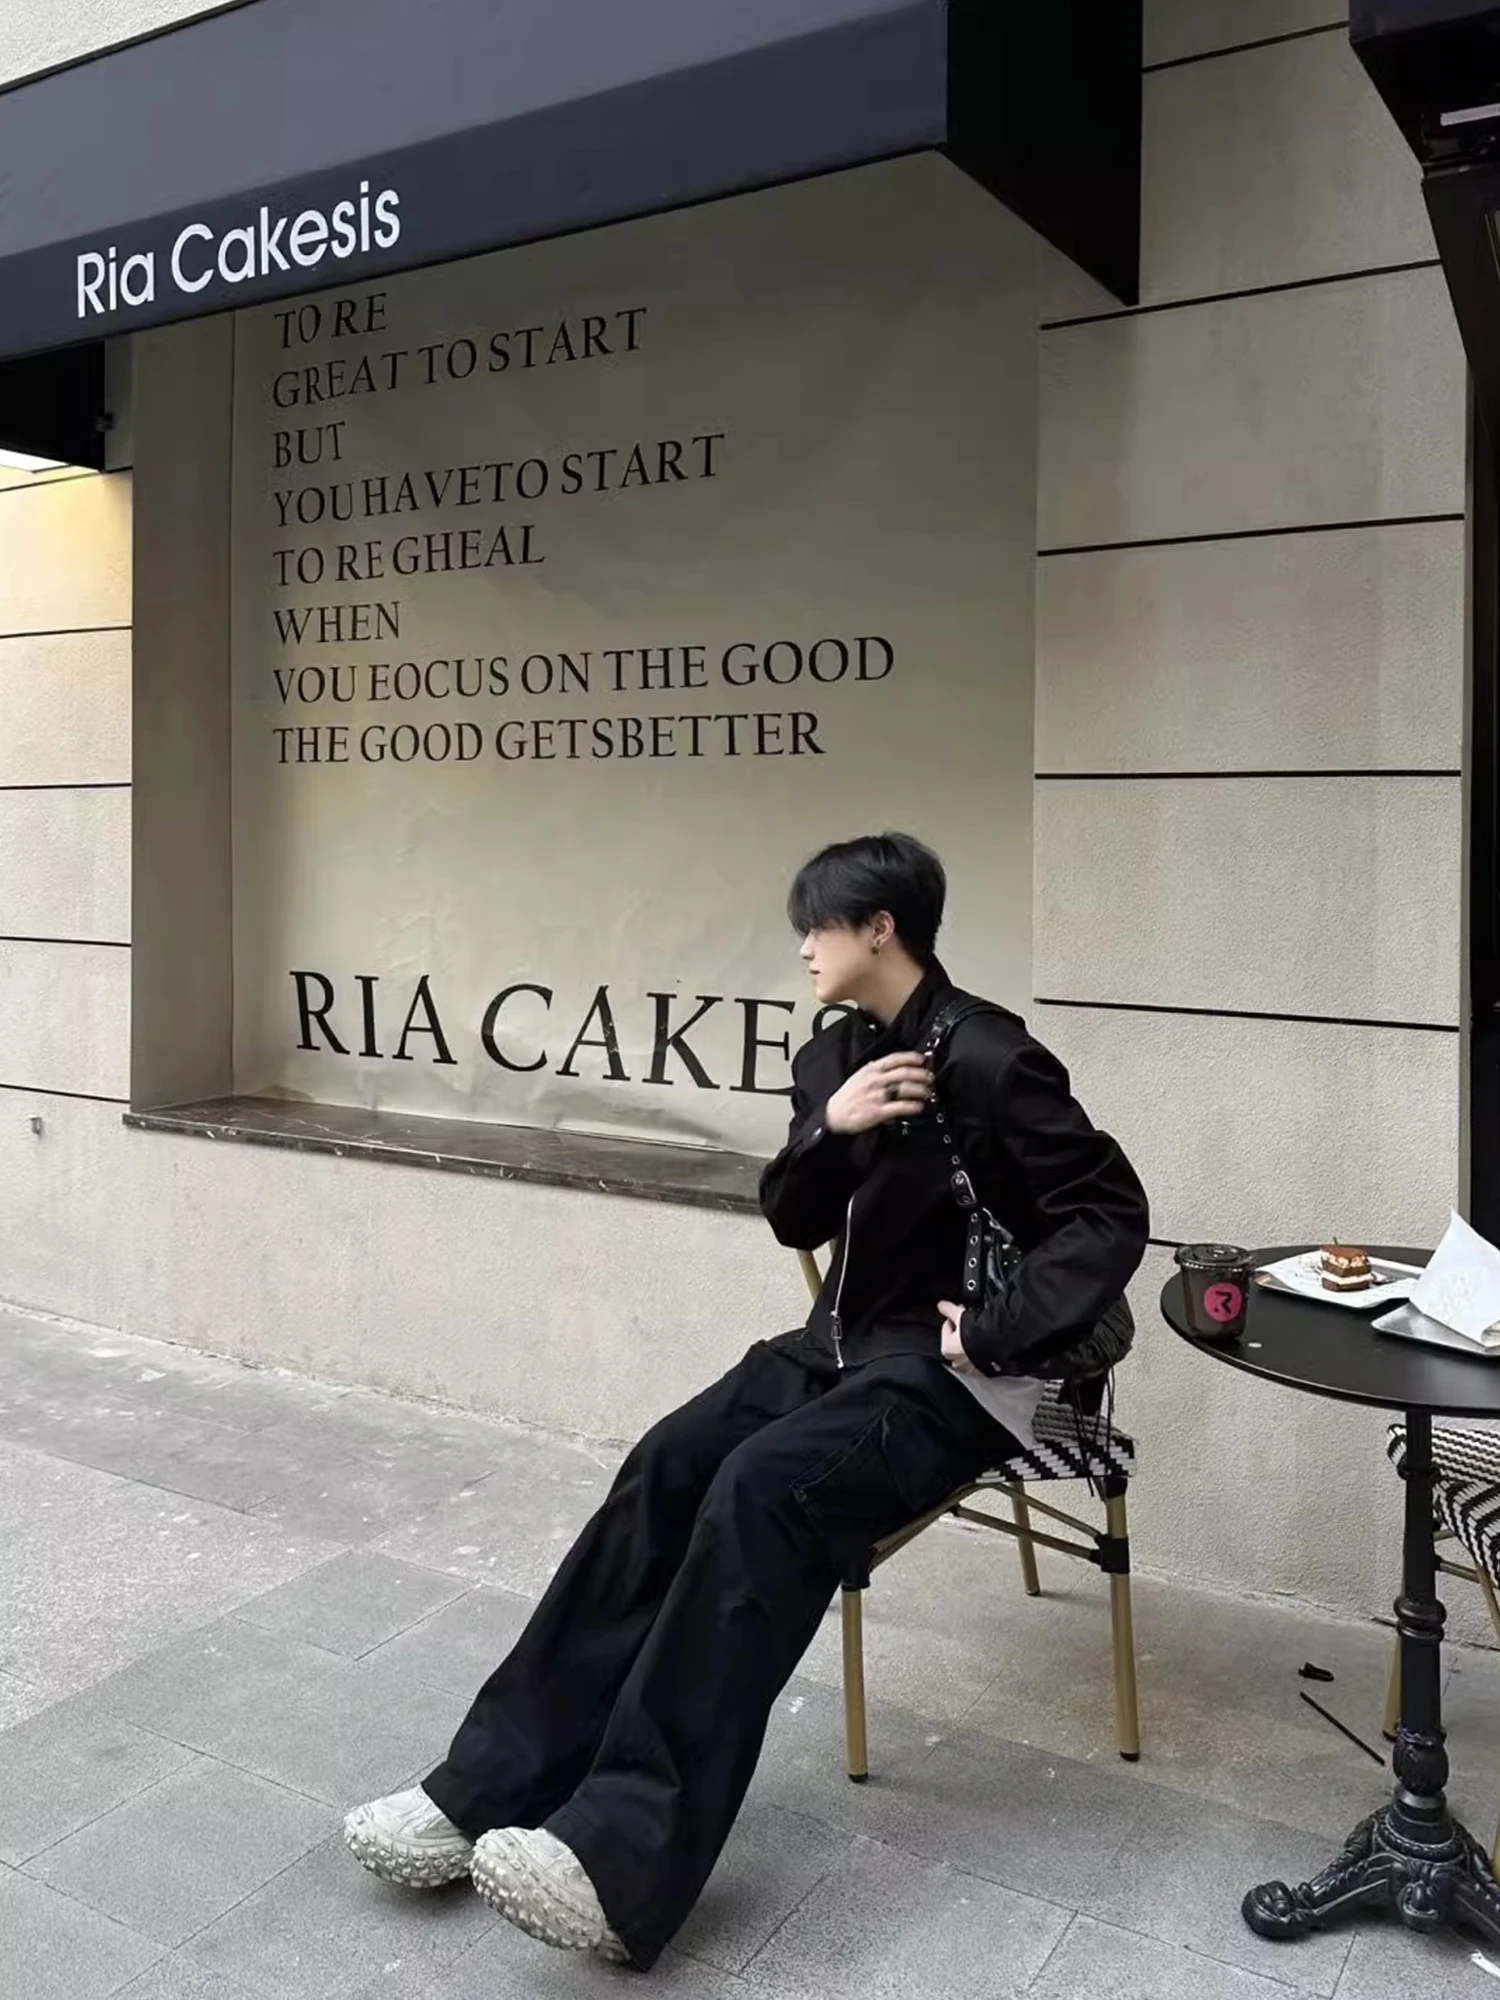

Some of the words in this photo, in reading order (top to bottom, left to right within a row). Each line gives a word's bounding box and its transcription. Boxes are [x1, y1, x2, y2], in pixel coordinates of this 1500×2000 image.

[77, 246, 155, 318] Ria
[171, 181, 400, 293] Cakesis
[274, 304, 322, 349] TO
[272, 350, 408, 408] GREAT
[418, 343, 478, 385] TO
[488, 307, 647, 373] START
[274, 421, 346, 468] BUT
[273, 482, 354, 528] YOU
[560, 433, 726, 495] START
[273, 546, 325, 587] TO
[273, 601, 400, 647] WHEN
[520, 651, 592, 695] ON
[603, 645, 710, 691] THE
[720, 635, 895, 686] GOOD
[273, 725, 350, 764] THE
[359, 722, 484, 763] GOOD
[289, 970, 458, 1066] RIA
